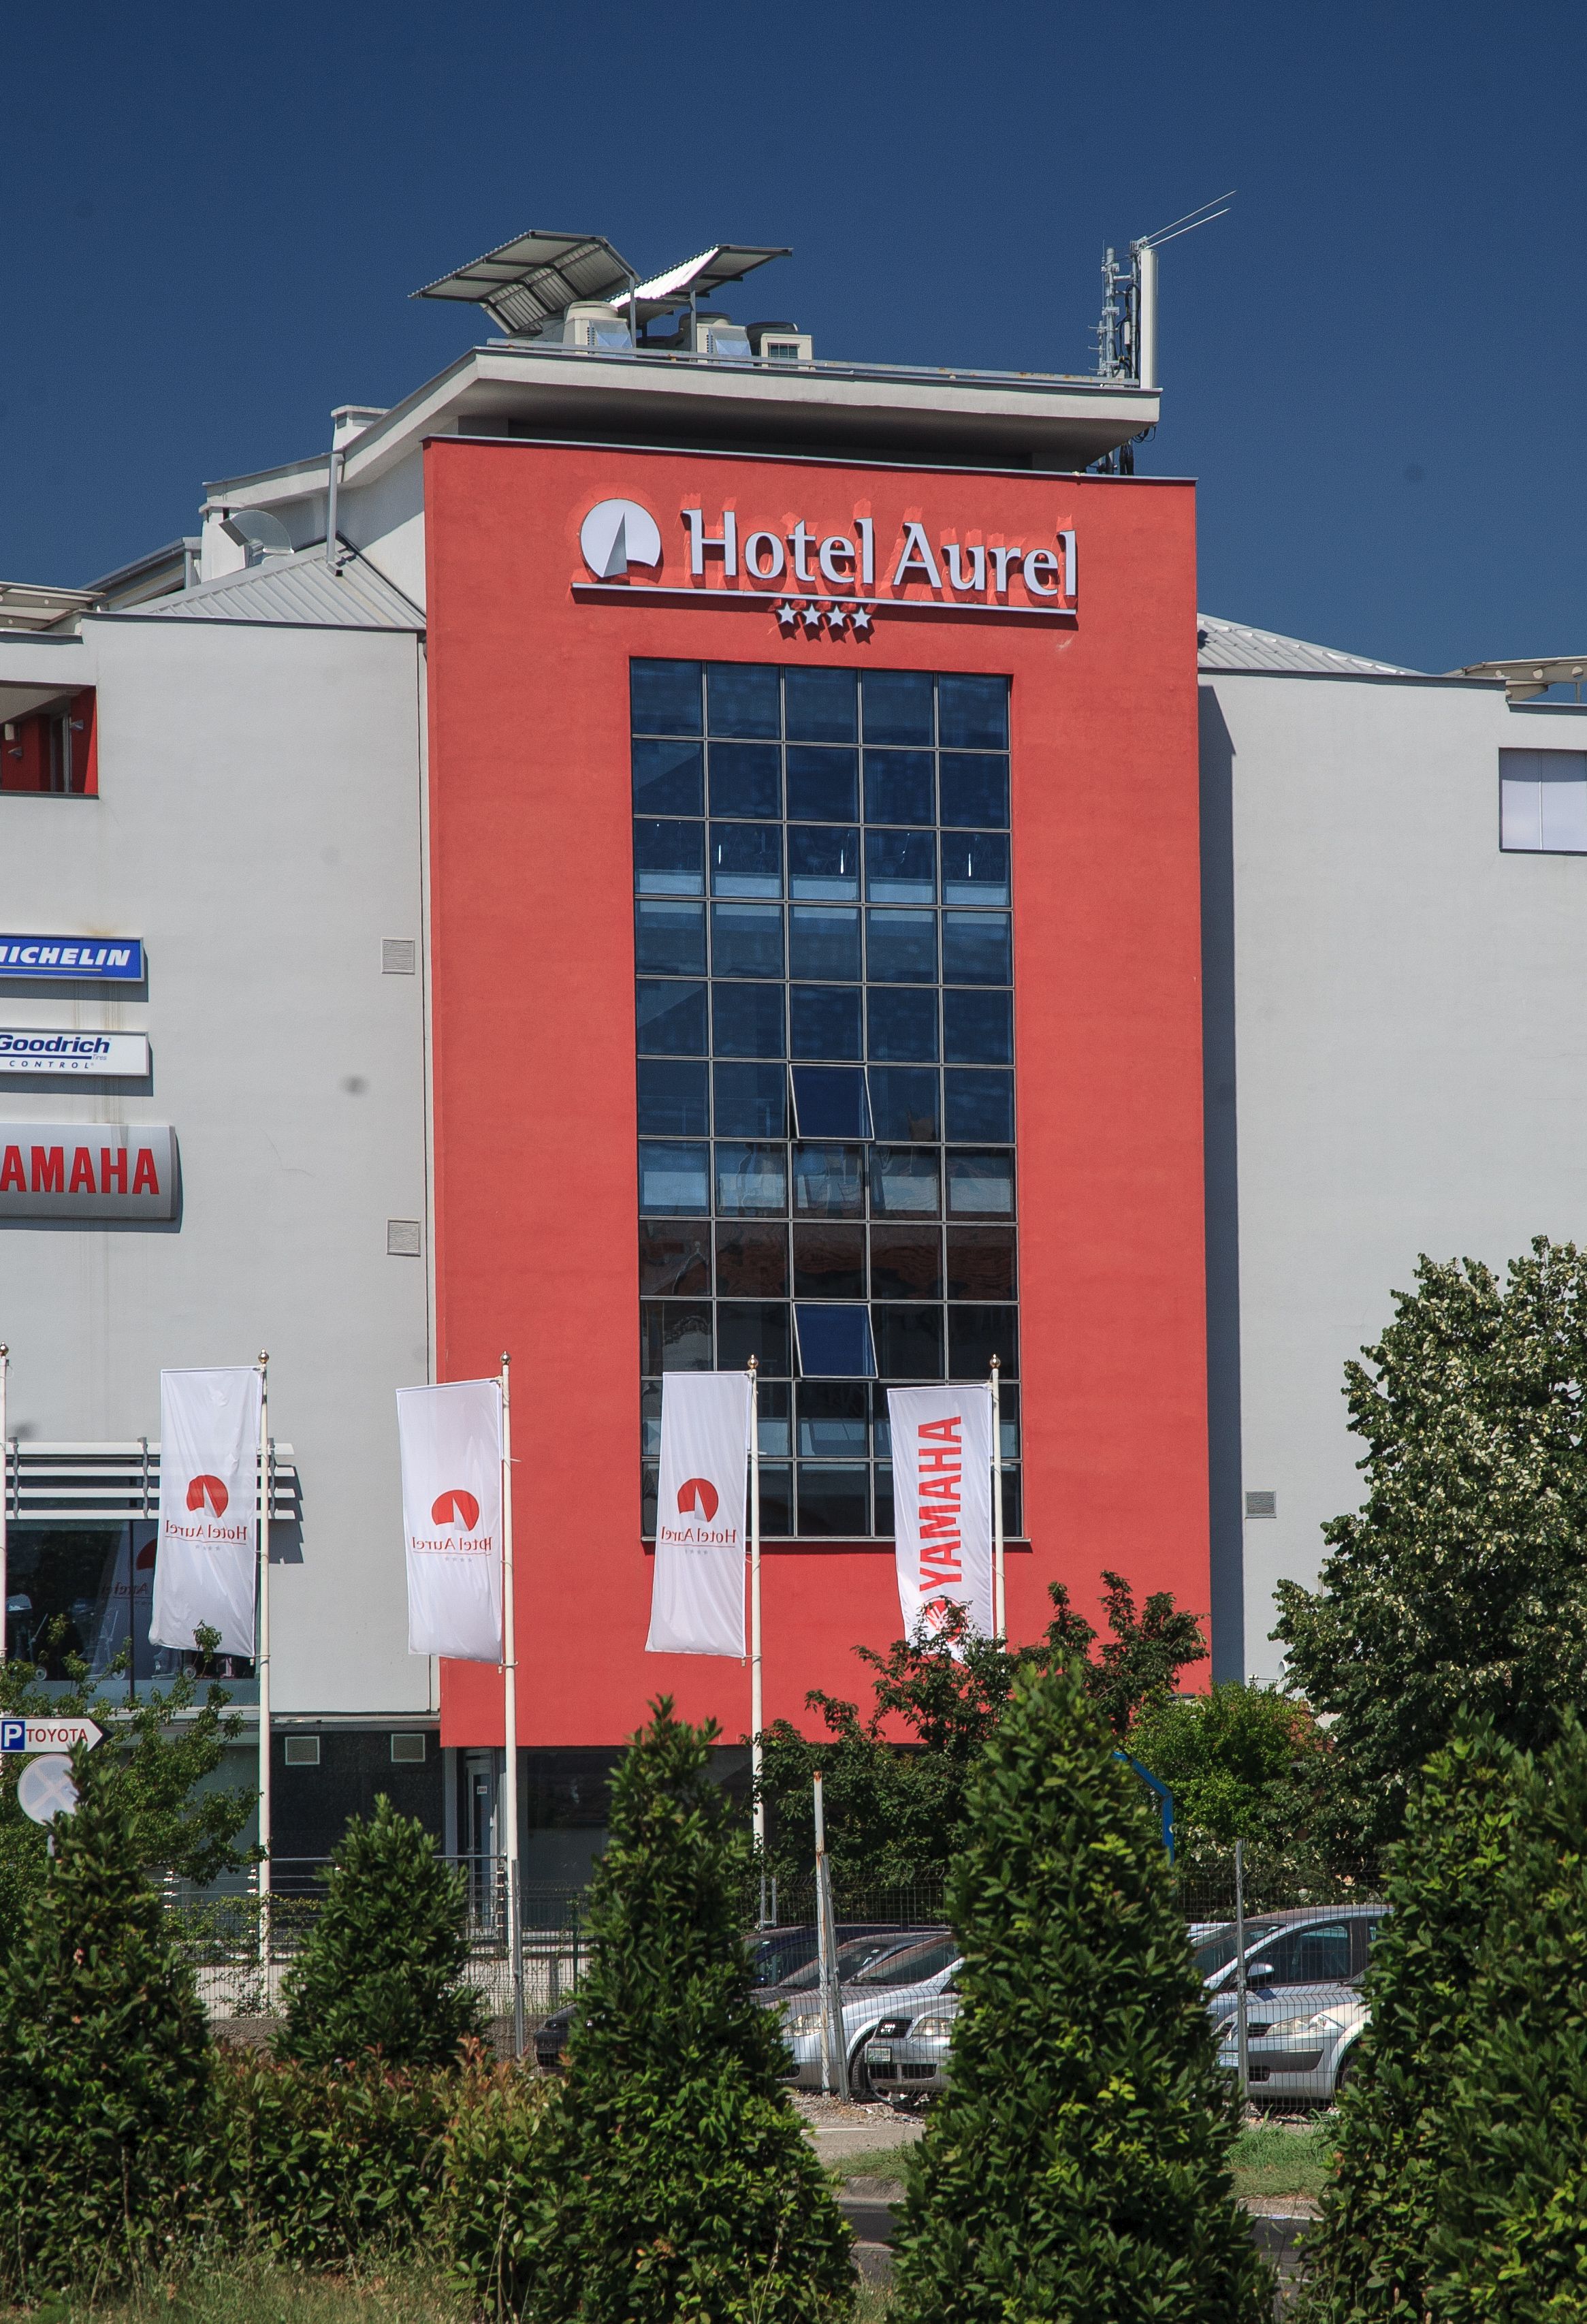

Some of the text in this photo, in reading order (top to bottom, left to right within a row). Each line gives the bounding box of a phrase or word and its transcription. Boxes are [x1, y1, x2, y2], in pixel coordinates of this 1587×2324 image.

[682, 508, 1076, 596] Hotel Aurel
[10, 1060, 89, 1069] CONTROL
[918, 1416, 962, 1592] YAMAHA
[26, 1728, 89, 1742] TOYOTA
